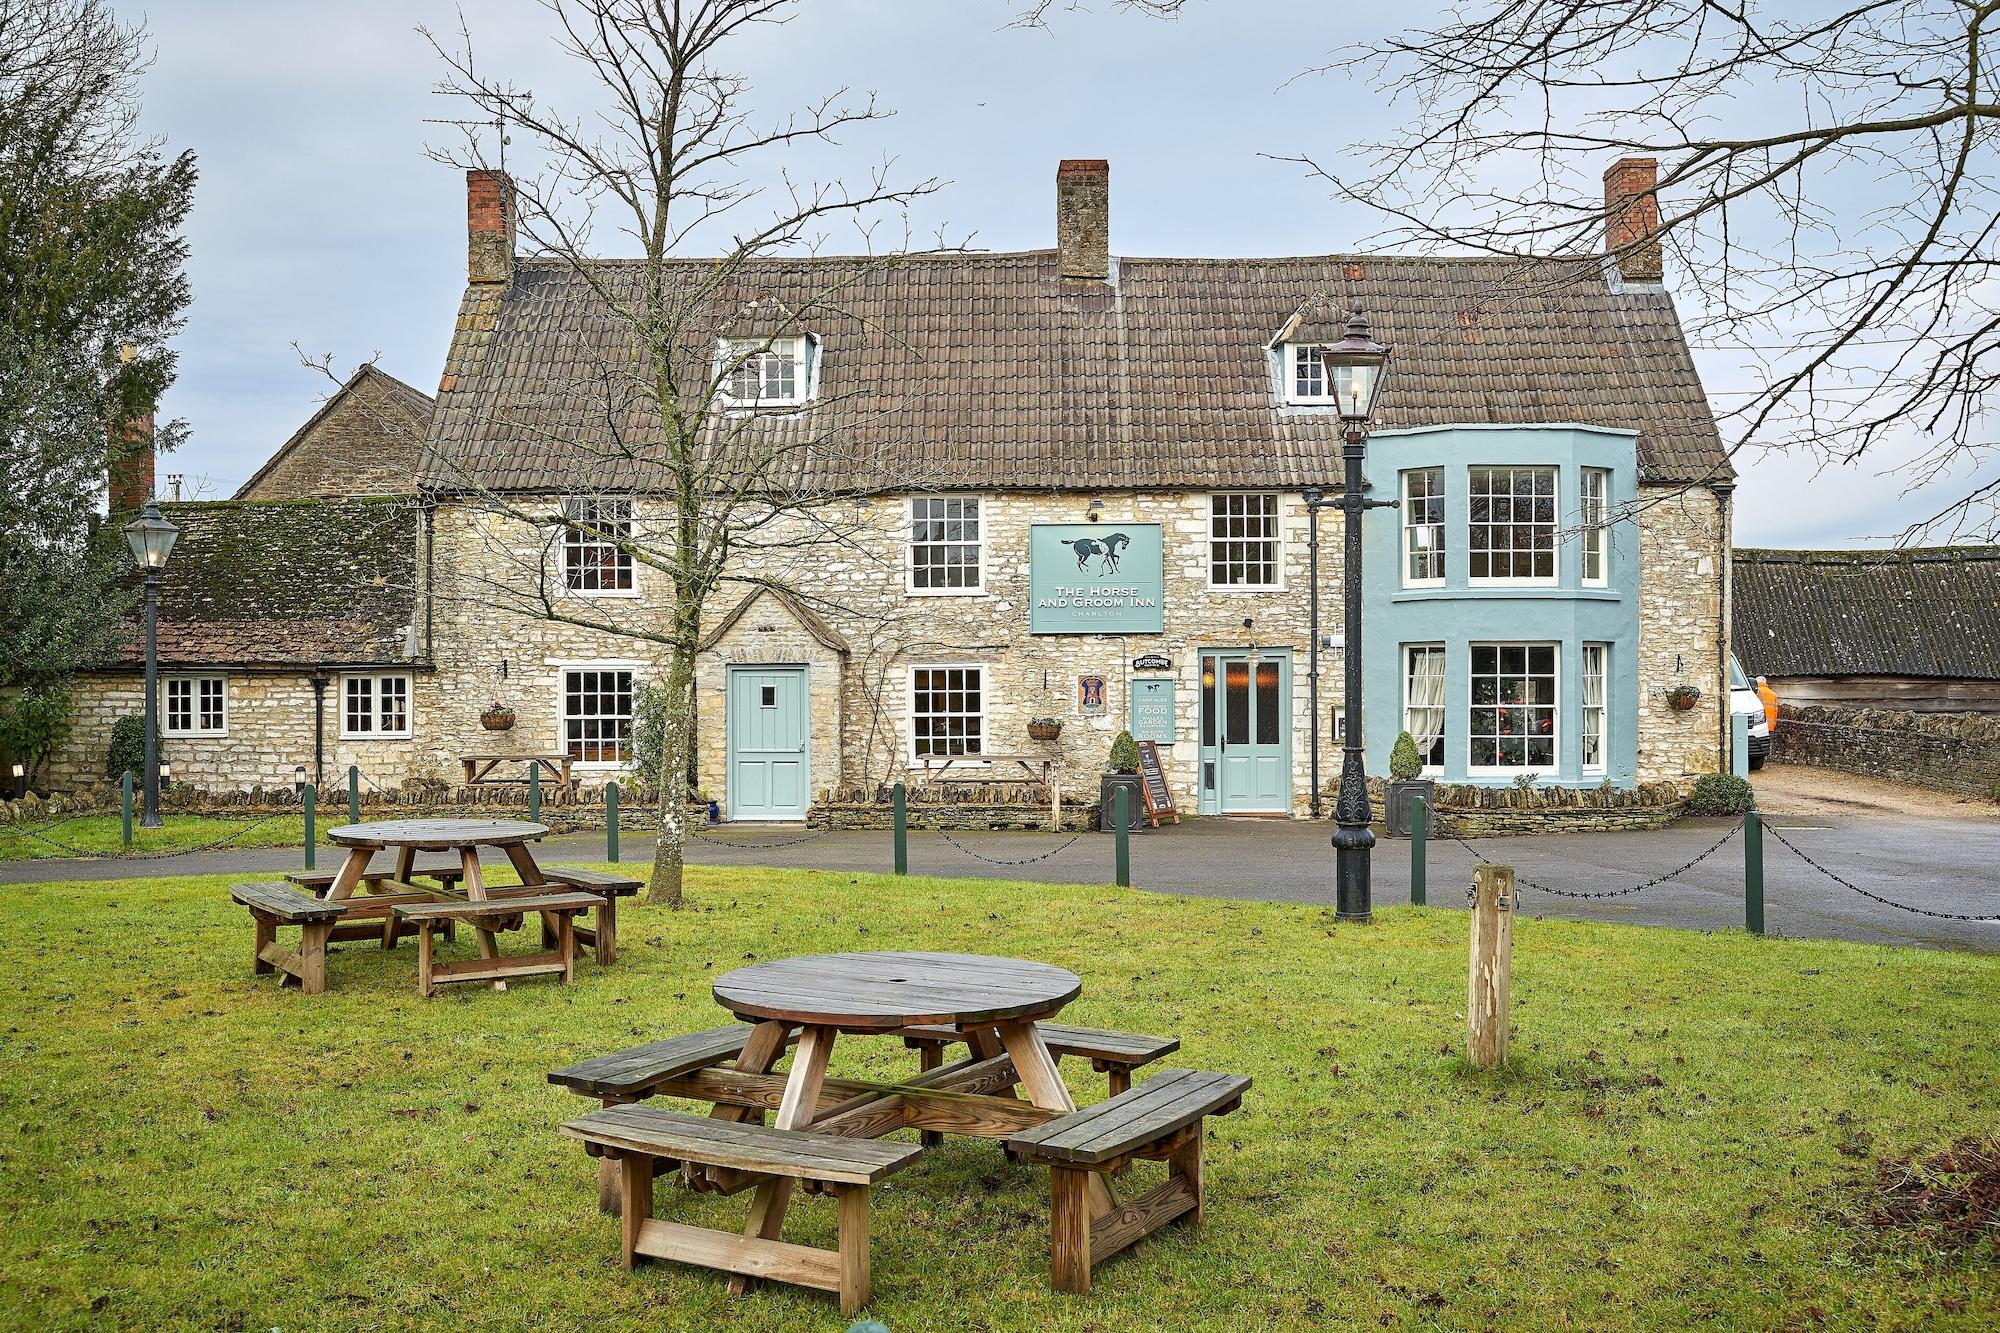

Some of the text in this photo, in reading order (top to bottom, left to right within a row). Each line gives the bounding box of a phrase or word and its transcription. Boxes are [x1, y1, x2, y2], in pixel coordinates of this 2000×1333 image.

[1055, 585, 1139, 597] THE HORSE
[1038, 597, 1156, 608] AND GROOM INN
[1135, 658, 1169, 668] BUTCOMBE
[1138, 707, 1168, 715] FOOD
